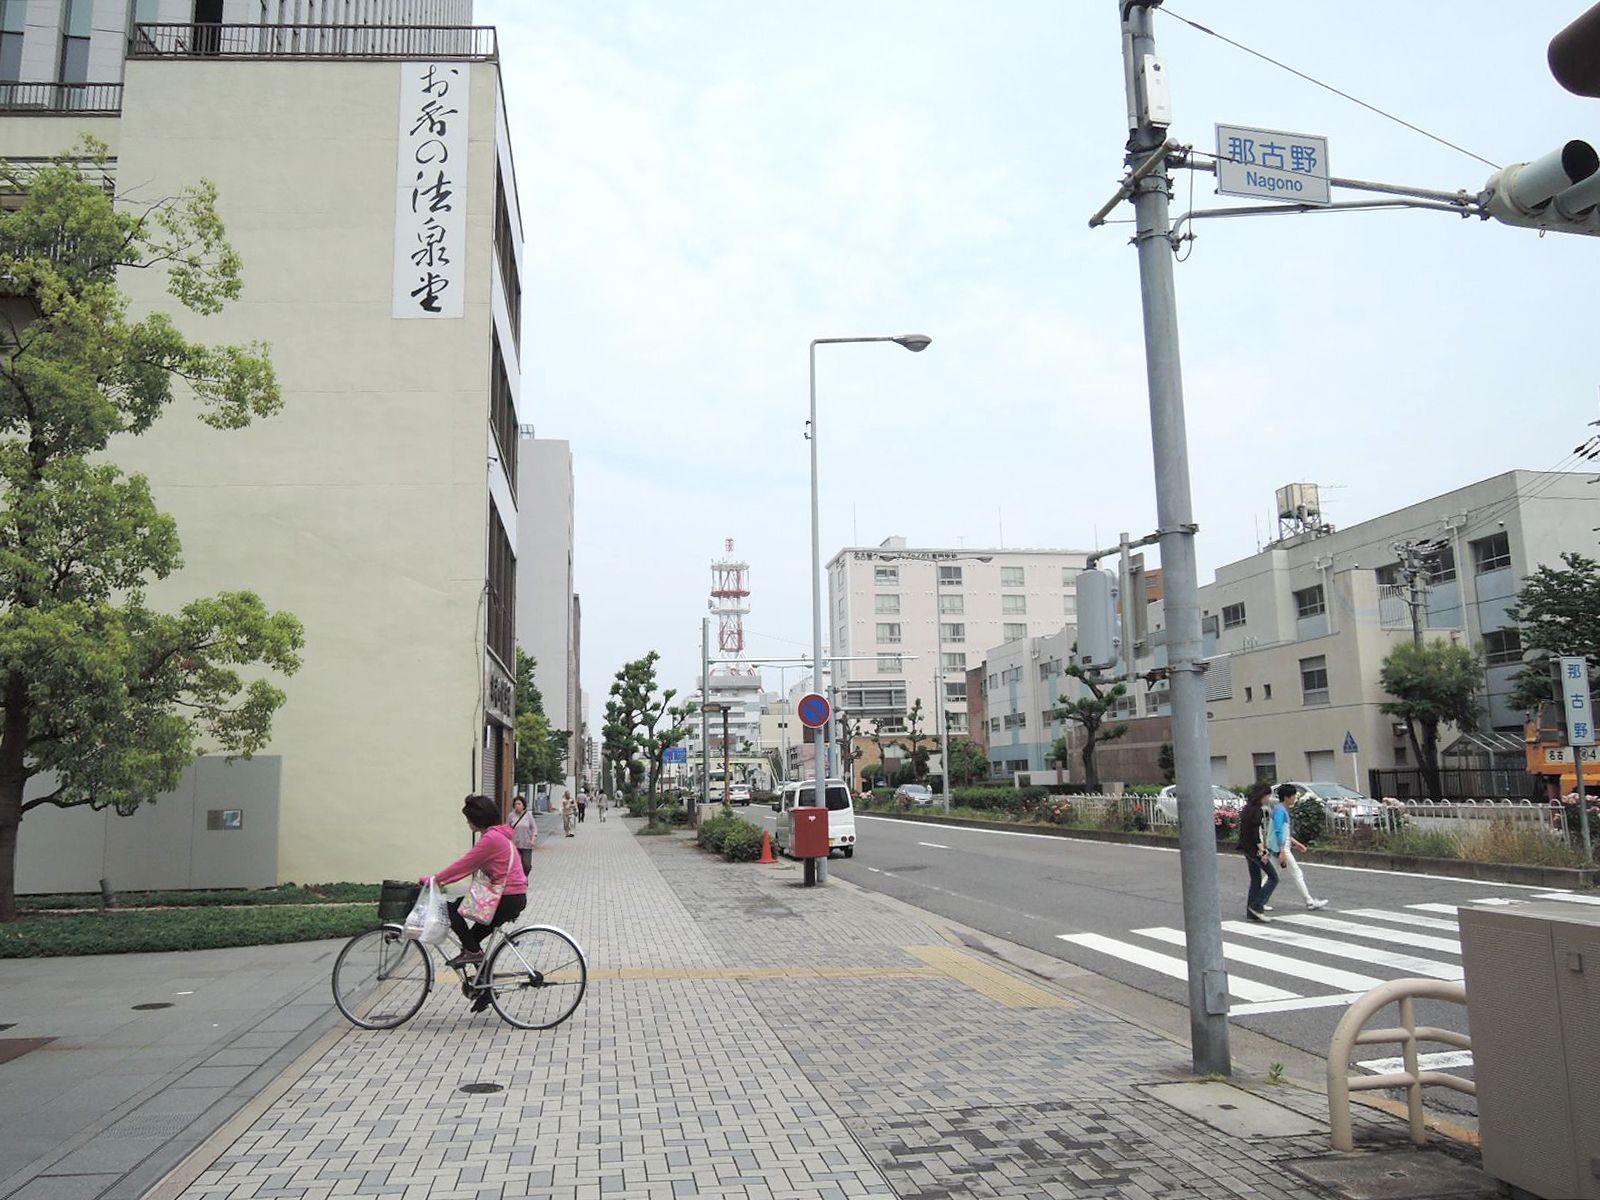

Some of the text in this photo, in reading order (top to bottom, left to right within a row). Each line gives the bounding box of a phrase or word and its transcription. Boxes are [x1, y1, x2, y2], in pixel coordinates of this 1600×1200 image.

[1228, 136, 1317, 173] 那古野
[1246, 171, 1303, 192] Nagono
[410, 64, 458, 312] お香の法泉堂
[1567, 664, 1588, 738] 那古野
